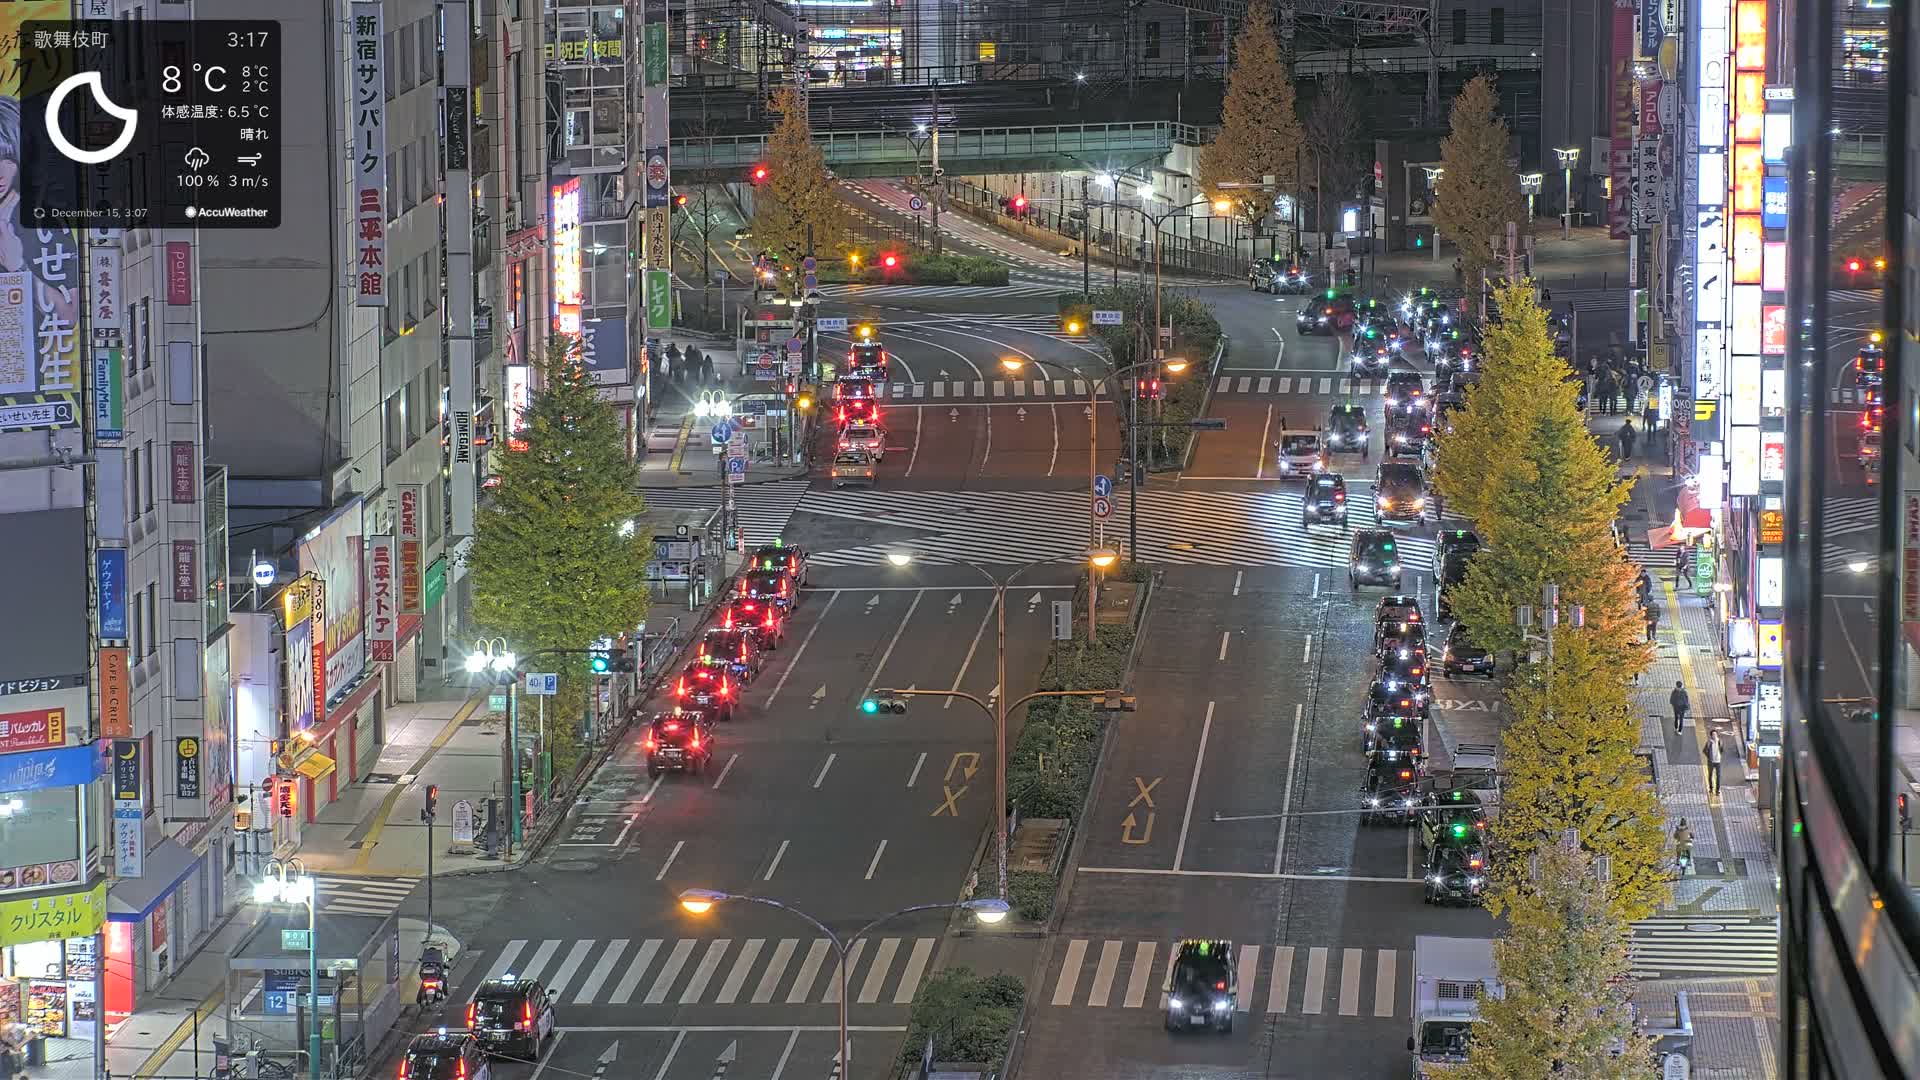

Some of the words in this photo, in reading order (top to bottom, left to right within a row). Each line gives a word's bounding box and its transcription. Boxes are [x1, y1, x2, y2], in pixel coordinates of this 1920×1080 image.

[560, 41, 586, 58] 祝日
[357, 15, 379, 174] 新宿サンパーク
[360, 189, 382, 296] 三平本館
[652, 212, 665, 266] 肉汁水餃子
[98, 272, 113, 319] 喜久屋
[651, 280, 665, 317] レイク
[99, 329, 116, 337] 3F
[98, 358, 109, 418] FamilyMart
[402, 491, 412, 535] GAME
[102, 560, 112, 609] ゲウチャイ
[178, 551, 191, 587] 龍生堂
[374, 547, 391, 633] 三平ストア
[10, 720, 46, 735] パムッカレ
[50, 716, 60, 740] 5F
[120, 822, 128, 862] ゲウチャイ
[11, 906, 82, 931] クリスタル
[269, 996, 283, 1009] 12
